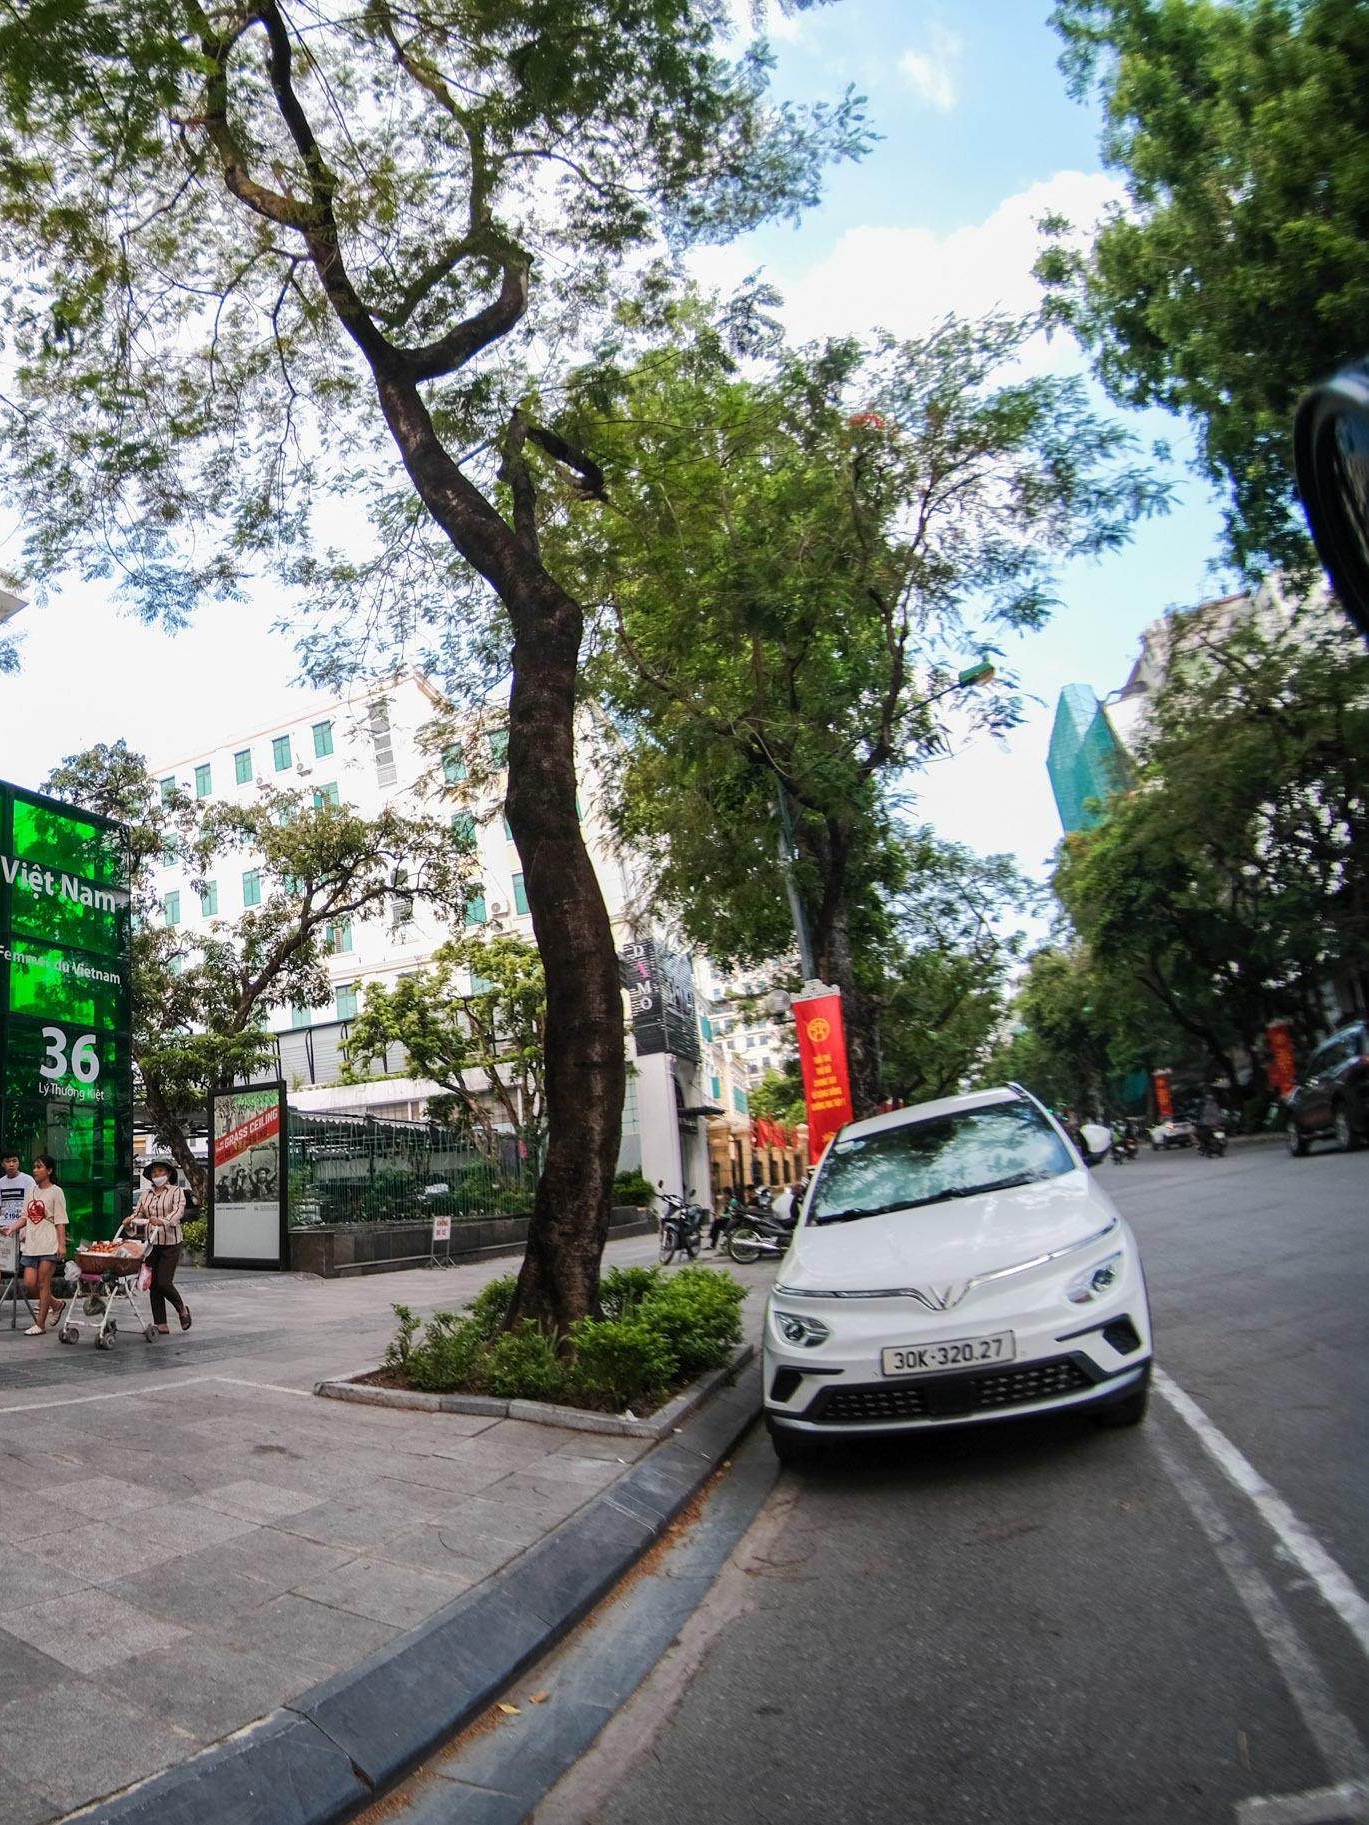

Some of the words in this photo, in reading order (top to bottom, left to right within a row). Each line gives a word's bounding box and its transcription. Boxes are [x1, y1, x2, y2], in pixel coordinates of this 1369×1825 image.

[1, 855, 54, 899] Việt
[61, 874, 116, 914] Nam
[54, 961, 70, 974] du
[72, 962, 121, 985] Vietnam
[39, 1026, 100, 1083] 36
[38, 1082, 49, 1097] Lý
[249, 1108, 278, 1134] CEILING
[894, 1338, 1003, 1370] 30K-320.27
